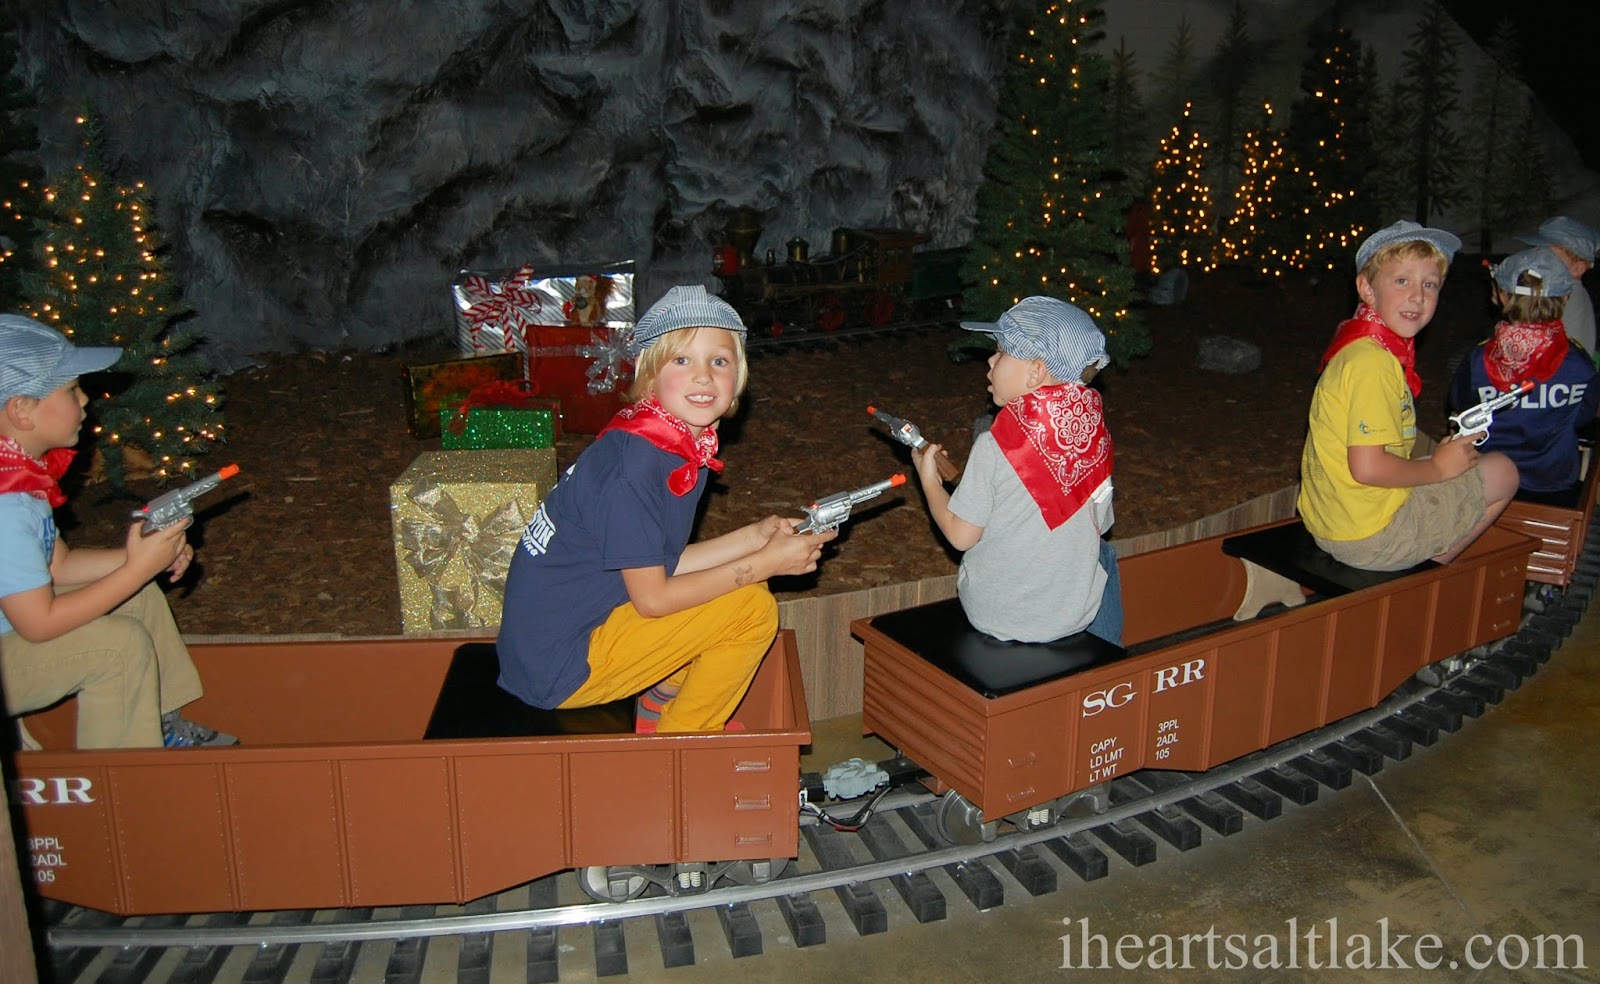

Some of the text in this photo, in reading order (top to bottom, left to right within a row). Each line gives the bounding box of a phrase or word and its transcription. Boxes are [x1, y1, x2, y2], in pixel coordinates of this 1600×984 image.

[1082, 659, 1205, 718] SG RR
[1090, 719, 1179, 755] CAPY 3PPL
[1090, 732, 1178, 769] LD LMT 2ADL
[1089, 747, 1170, 783] LT WT 105
[14, 777, 96, 804] RR
[36, 870, 55, 882] 05
